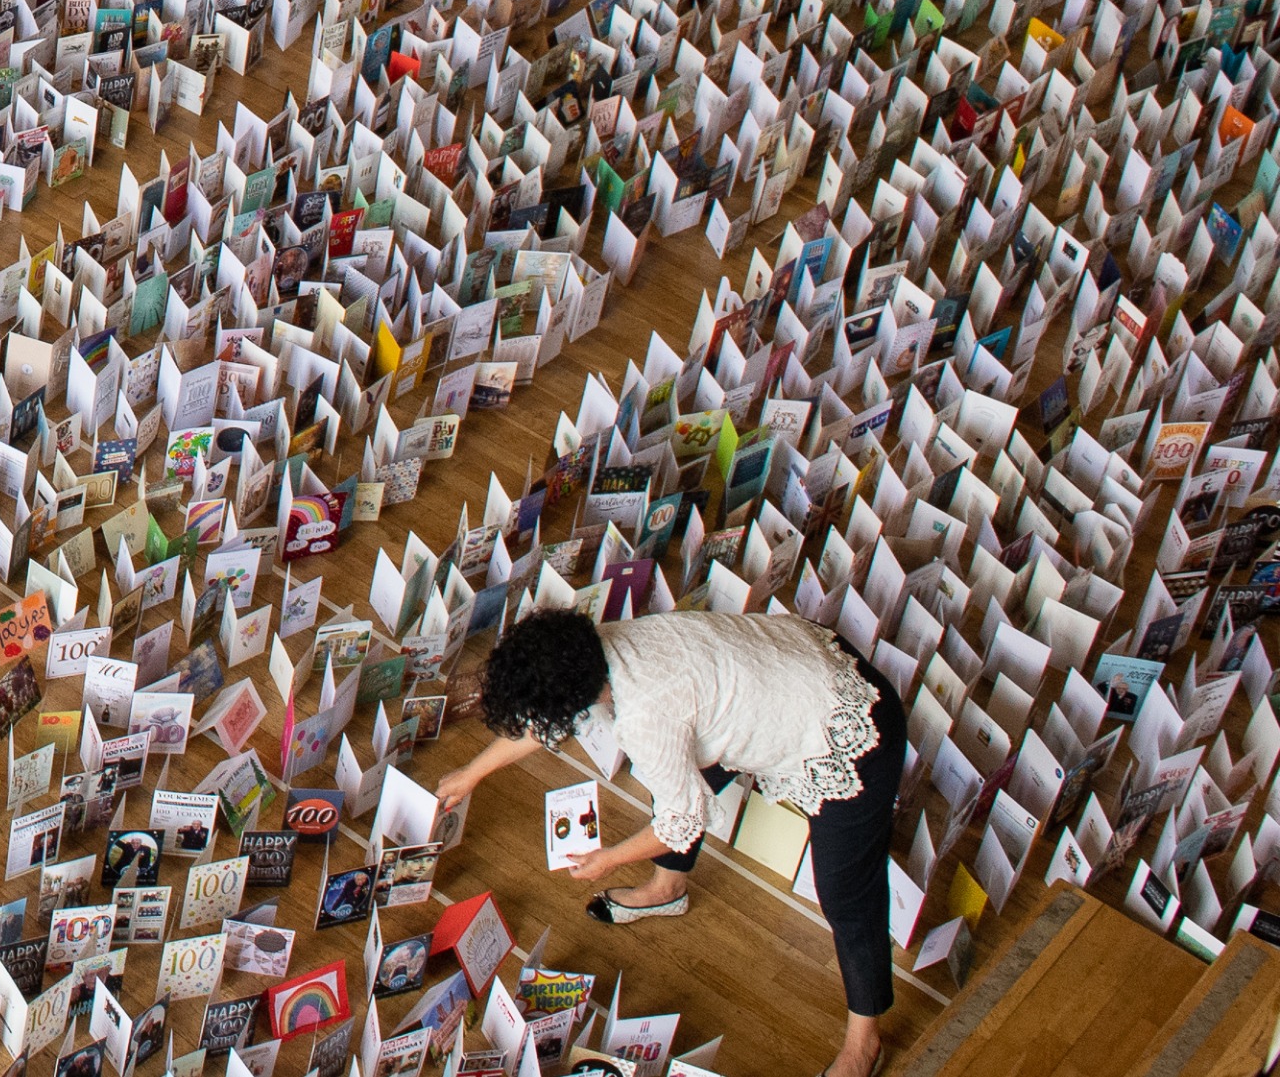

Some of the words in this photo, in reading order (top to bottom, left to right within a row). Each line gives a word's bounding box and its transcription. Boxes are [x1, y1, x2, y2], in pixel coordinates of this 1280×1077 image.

[1231, 421, 1267, 435] HAPPY
[1155, 442, 1193, 460] 100
[1211, 457, 1253, 472] HAPPY
[650, 506, 673, 527] 100
[1218, 590, 1265, 606] HAPPY
[157, 792, 180, 801] YOUR
[189, 794, 215, 803] TIMES
[287, 805, 335, 824] 100
[244, 835, 296, 850] HAPPY
[195, 870, 239, 902] 100
[52, 914, 113, 944] 100
[171, 944, 217, 976] 100
[521, 978, 592, 1000] BIRTHDAY
[31, 991, 66, 1027] 100
[208, 999, 257, 1019] HAPPY
[534, 994, 582, 1011] HERO!
[397, 1040, 426, 1053] TODAY
